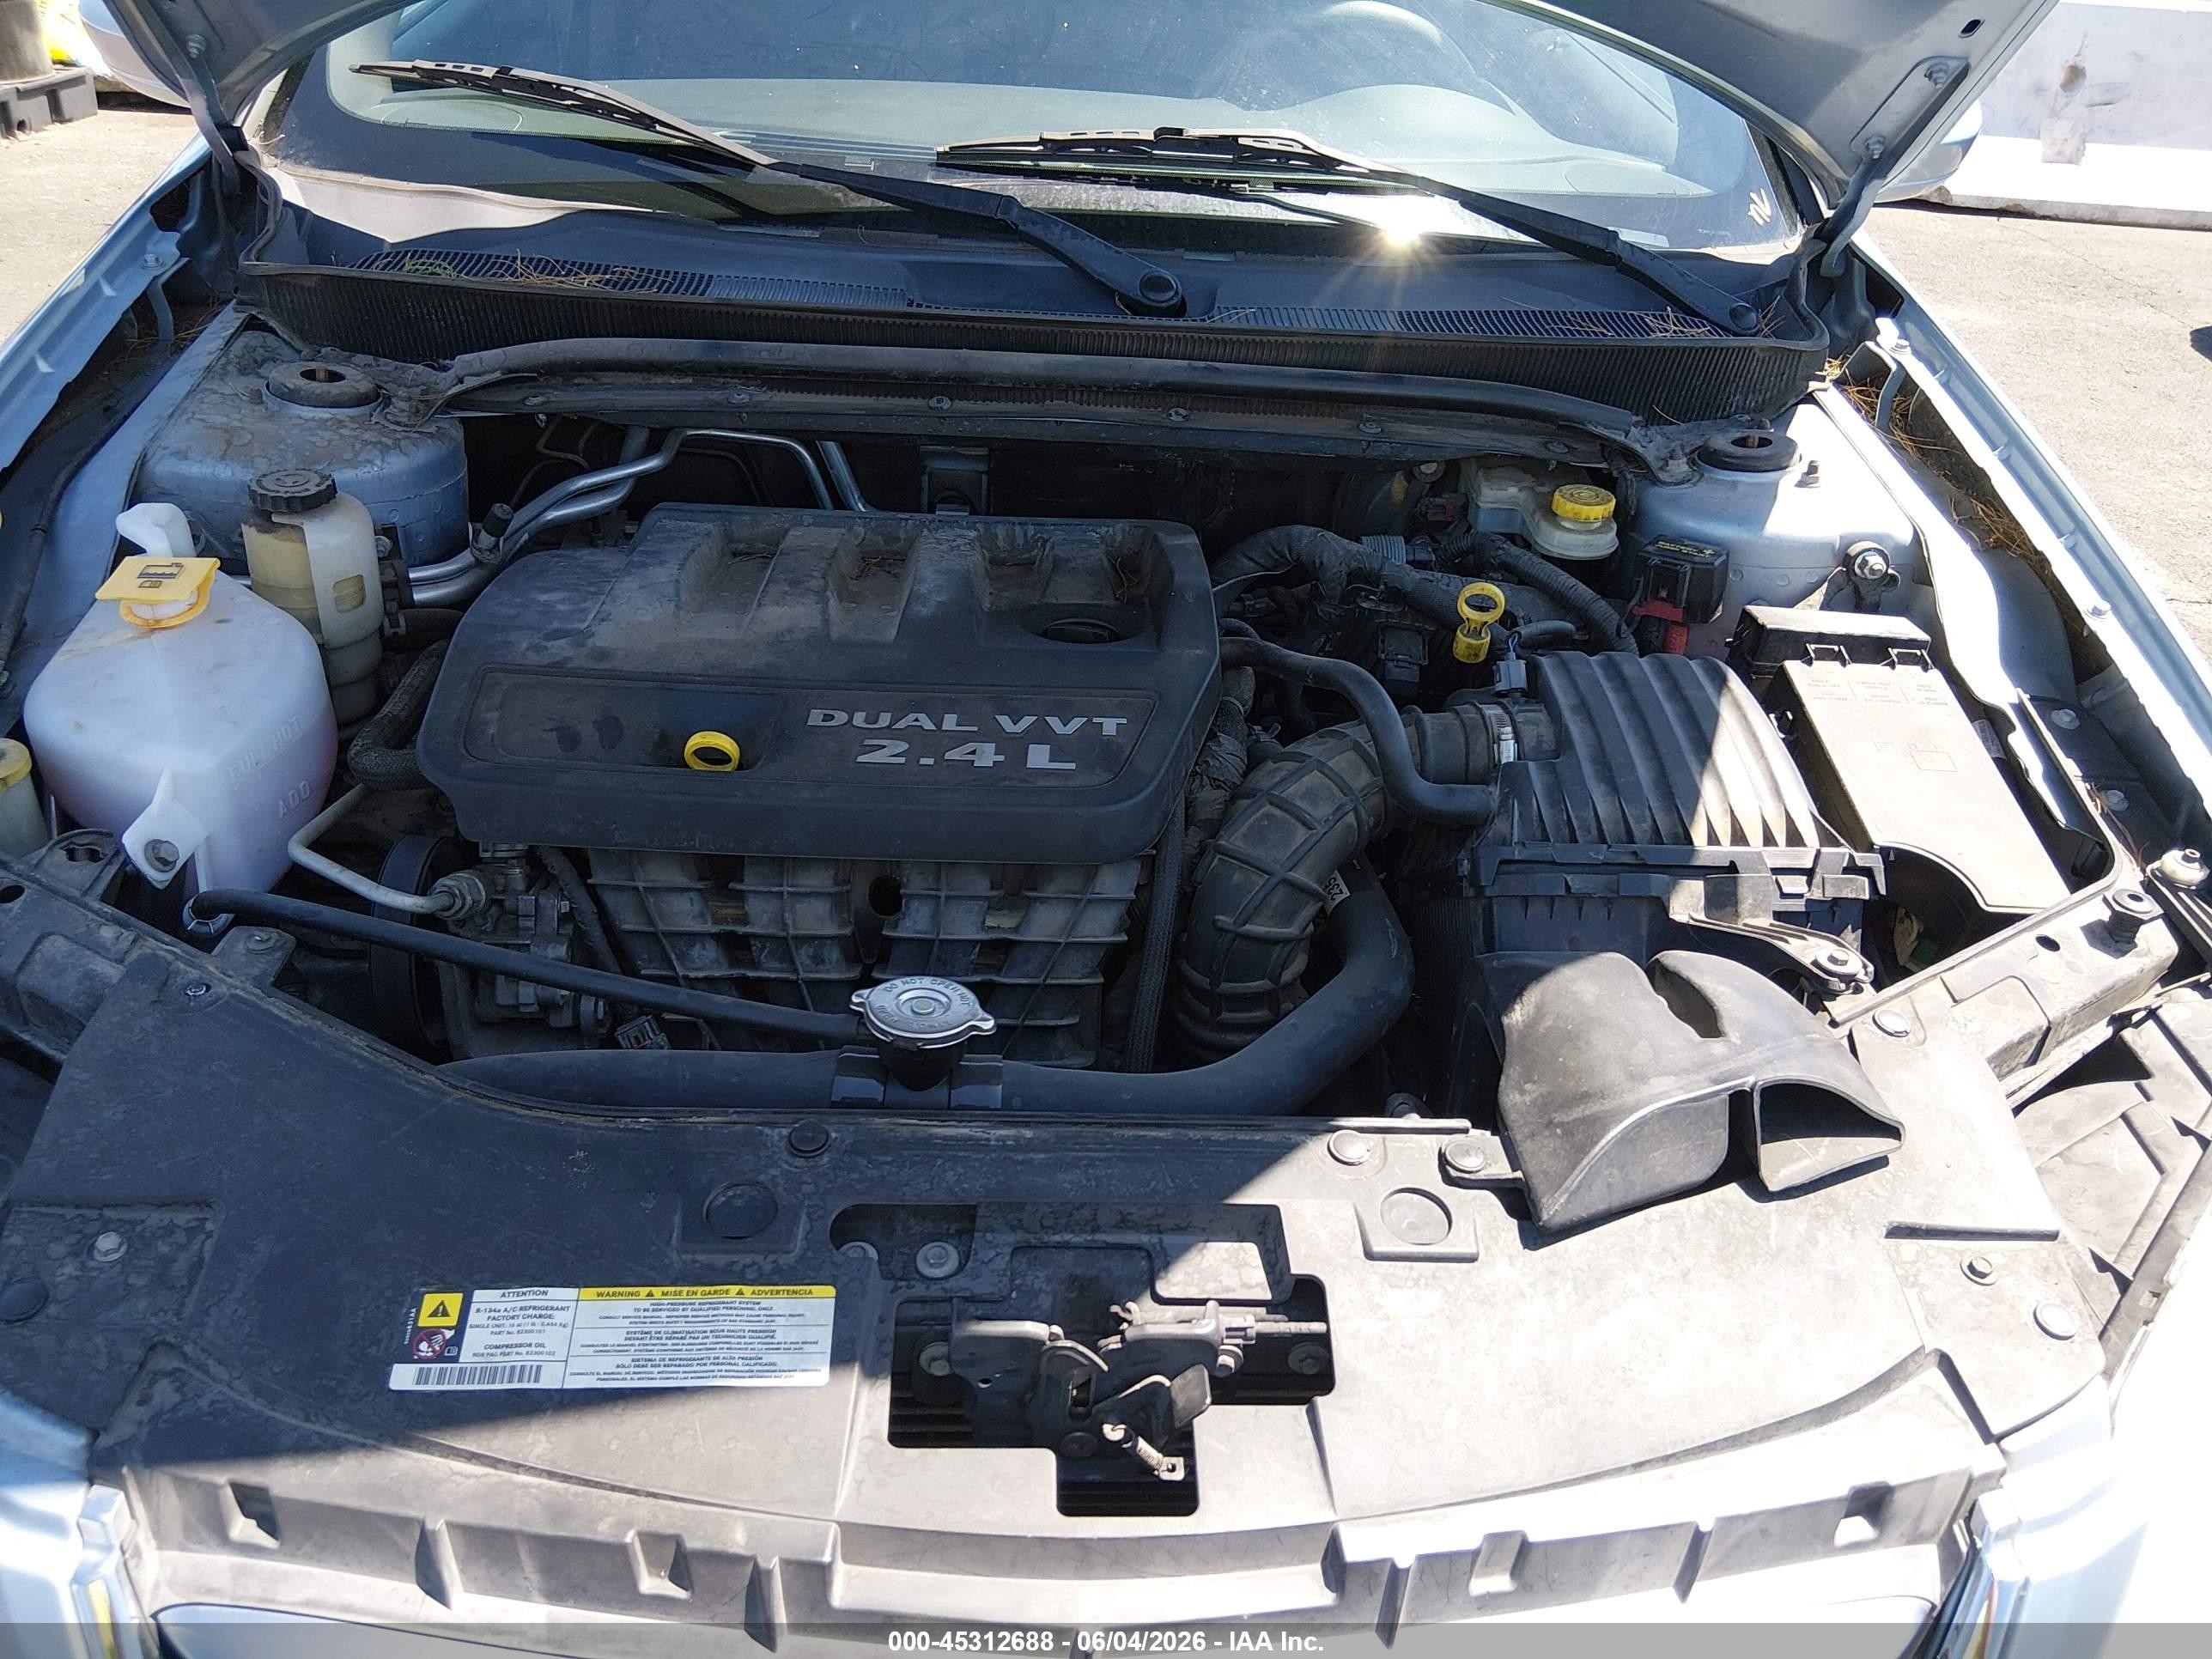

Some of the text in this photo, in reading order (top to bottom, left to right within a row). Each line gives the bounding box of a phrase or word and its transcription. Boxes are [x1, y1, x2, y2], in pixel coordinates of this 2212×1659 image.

[806, 708, 1127, 736] DUAL VVT
[278, 780, 311, 819] ADD
[884, 983, 898, 993] DO
[929, 979, 960, 993] OPEN
[501, 1289, 548, 1297] ATTENTION
